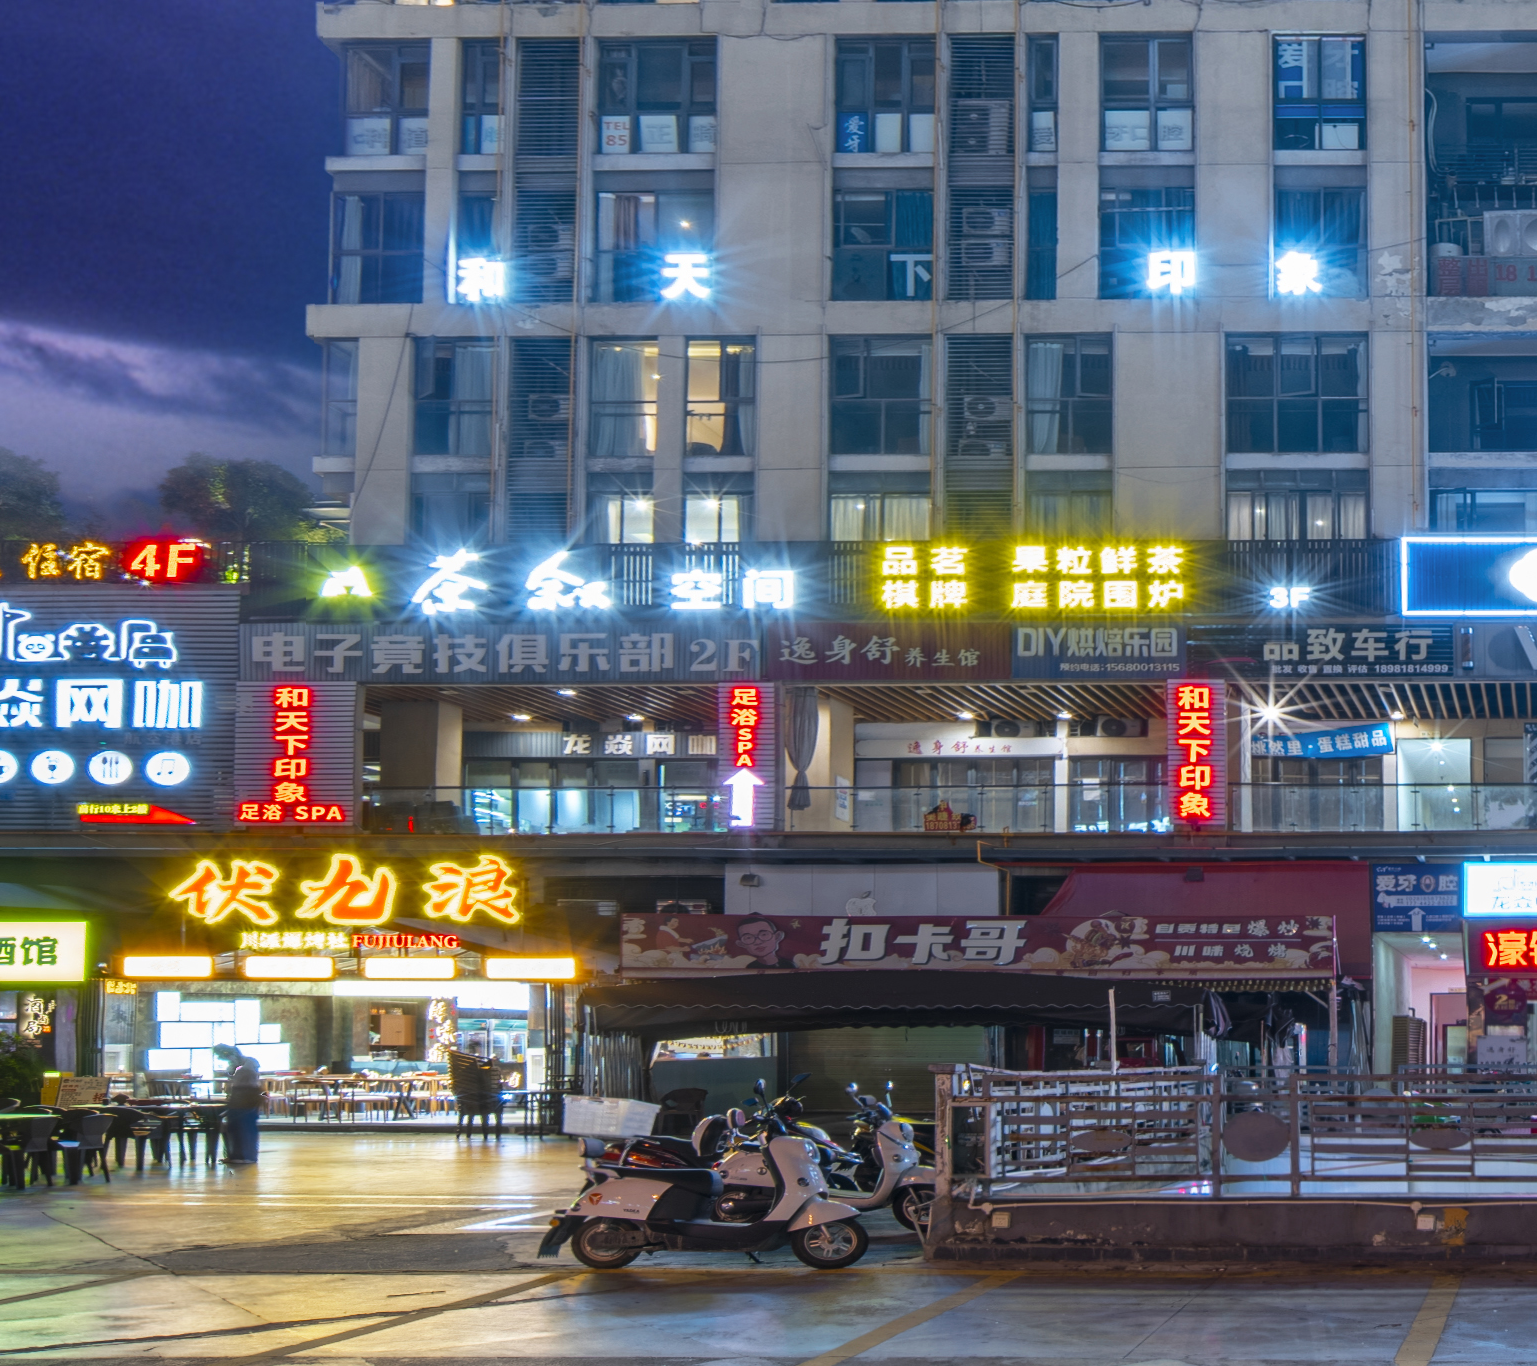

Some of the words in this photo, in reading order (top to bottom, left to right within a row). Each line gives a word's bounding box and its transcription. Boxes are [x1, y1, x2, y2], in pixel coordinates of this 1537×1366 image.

[604, 121, 630, 130] TEL
[606, 134, 627, 147] 85
[457, 251, 1322, 301] 和天下印象
[21, 541, 112, 581] 住宿
[131, 544, 196, 578] 4F
[882, 545, 969, 576] 品茗
[1011, 545, 1184, 576] 果粒鲜茶
[882, 579, 968, 609] 棋牌
[1011, 579, 1184, 610] 庭院围炉
[1270, 587, 1311, 609] 3F
[252, 632, 674, 674] 电子竞技俱乐部
[689, 638, 760, 672] 2F
[779, 634, 900, 665] 逸身舒
[905, 647, 981, 668] 养生馆
[1017, 627, 1178, 657] DIY烘焙乐园
[1263, 628, 1433, 661] 品致车行
[1347, 664, 1368, 674] 评估
[1374, 664, 1449, 674] 18981814999
[730, 688, 759, 767] 足浴SPA
[274, 686, 310, 804] 和天下印象
[563, 733, 717, 756] 龙焱网咖
[908, 739, 969, 755] 逸身舒
[974, 744, 1013, 754] 养生馆
[1177, 685, 1212, 819] 和天下印象
[239, 804, 283, 822] 足浴
[294, 804, 344, 822] SPA
[168, 852, 521, 925] 伏九浪
[351, 934, 460, 949] FUJIULANG
[820, 918, 1029, 966] 扣卡哥
[1155, 919, 1300, 937] 自贡特色爆炒
[1174, 943, 1288, 959] 川味烧烤
